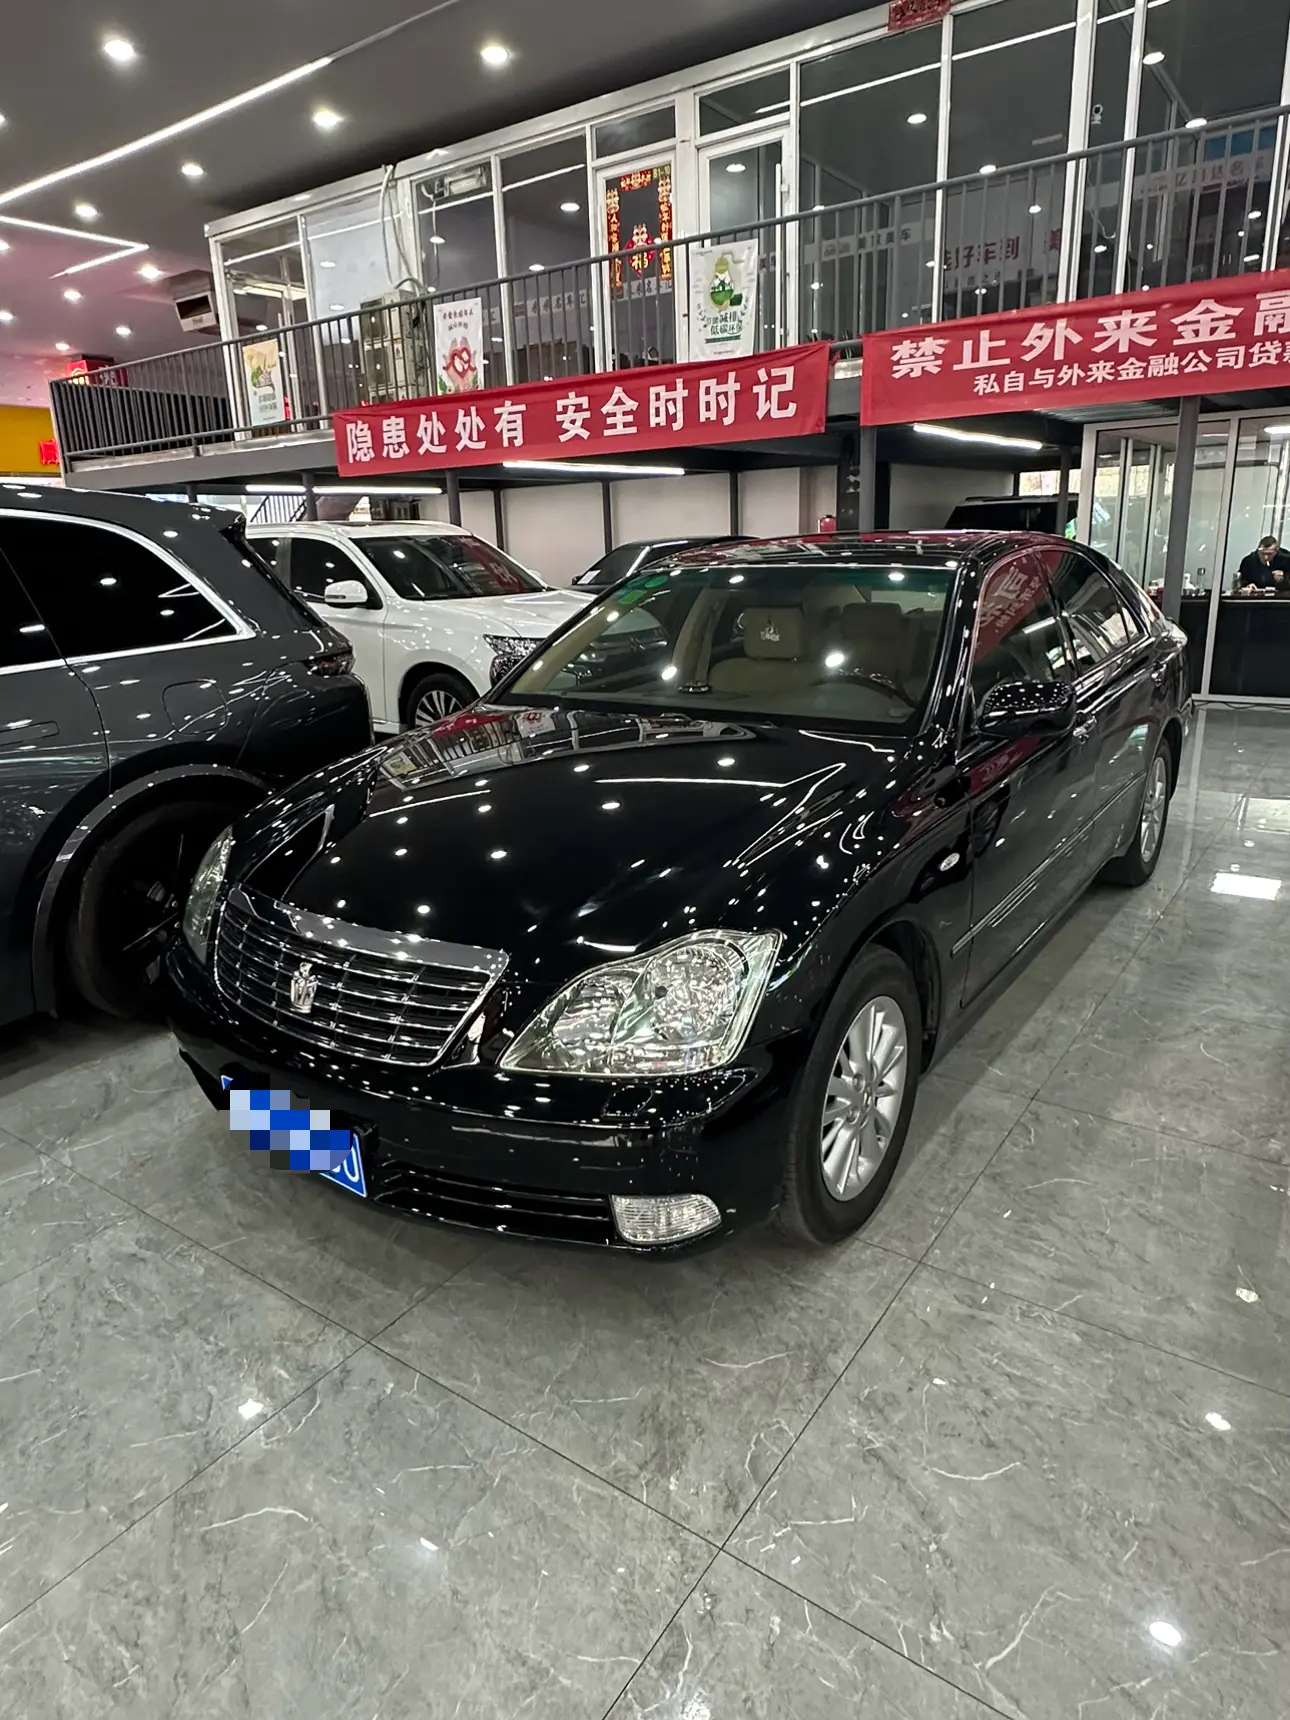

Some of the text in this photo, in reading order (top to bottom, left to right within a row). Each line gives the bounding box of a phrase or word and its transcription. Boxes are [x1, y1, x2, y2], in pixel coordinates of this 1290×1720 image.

[346, 365, 797, 464] 隐患处处有 安全时时记
